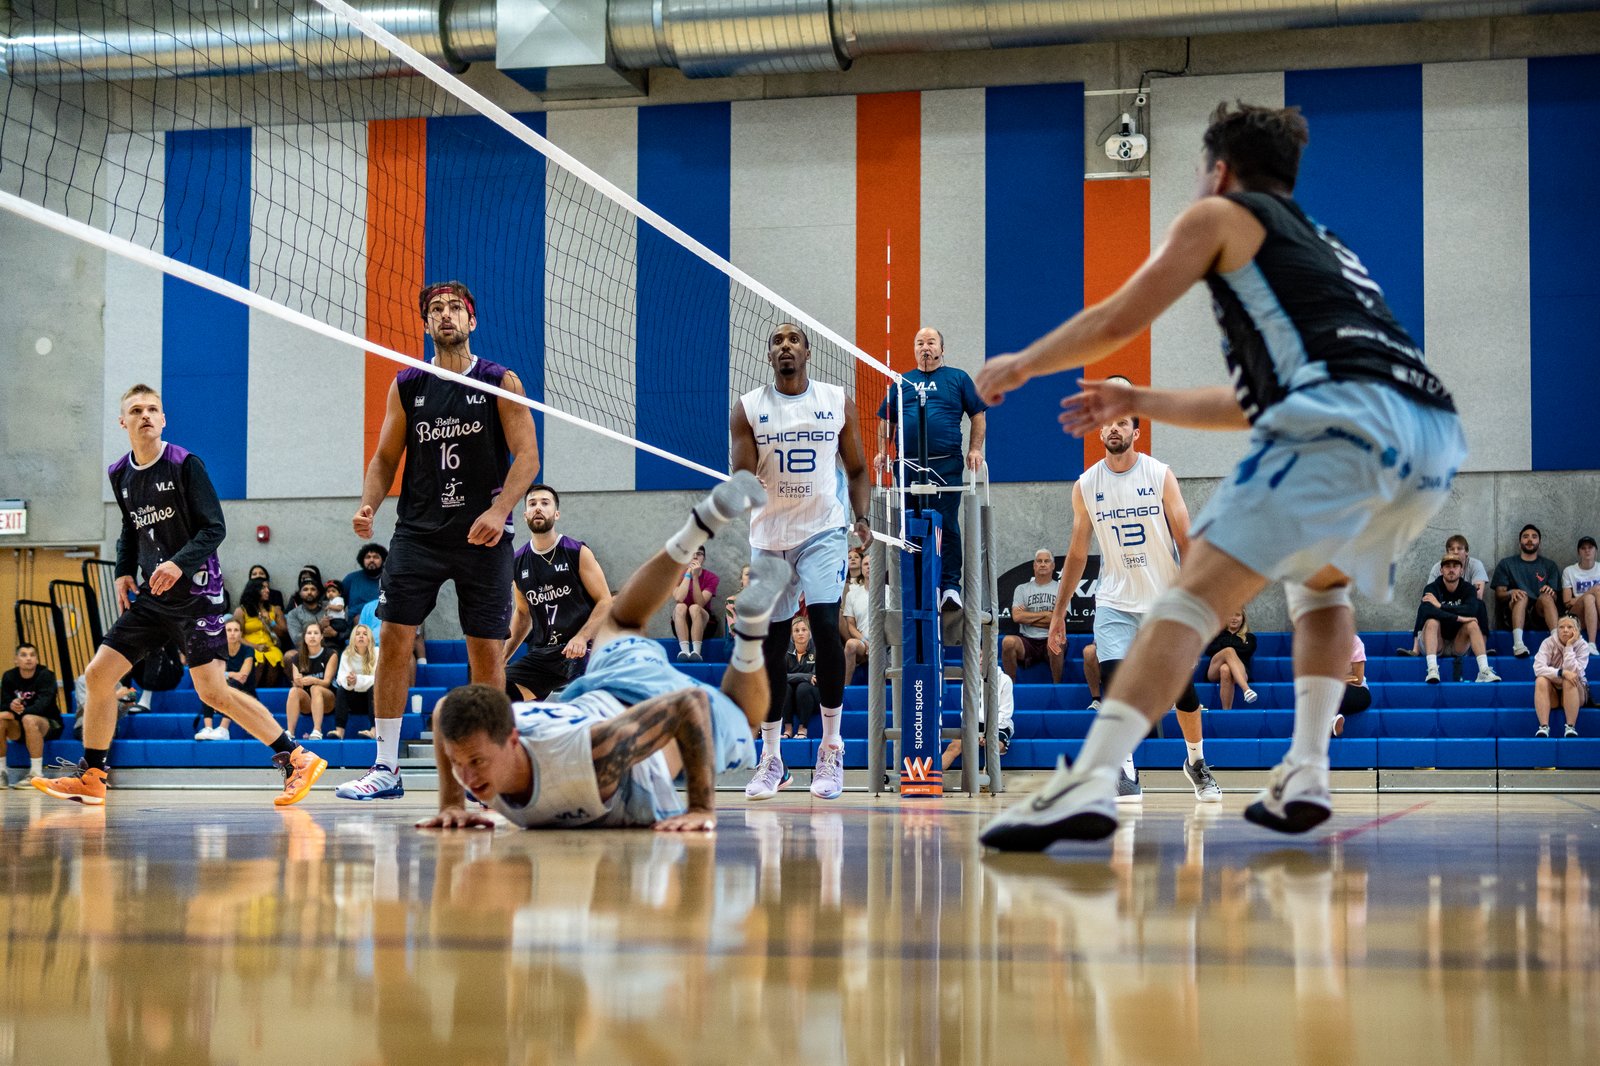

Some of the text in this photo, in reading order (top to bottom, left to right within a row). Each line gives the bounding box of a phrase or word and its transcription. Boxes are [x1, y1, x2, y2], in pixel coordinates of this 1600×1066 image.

[913, 381, 938, 391] VLA
[466, 394, 486, 404] VLA
[435, 416, 460, 427] Boston
[814, 411, 834, 419] VLA
[416, 420, 484, 443] Bounce
[757, 431, 835, 445] CHICAGO
[440, 442, 460, 470] 16
[774, 449, 816, 473] 18
[156, 481, 175, 491] VLA
[1137, 487, 1155, 496] VLA
[0, 513, 22, 529] EXIT
[1096, 506, 1160, 522] CHICAGO
[1111, 523, 1146, 547] 13
[554, 563, 569, 572] VLA
[525, 585, 572, 606] Bounce
[1027, 592, 1057, 606] ERSKINE
[914, 680, 923, 750] sports imports
